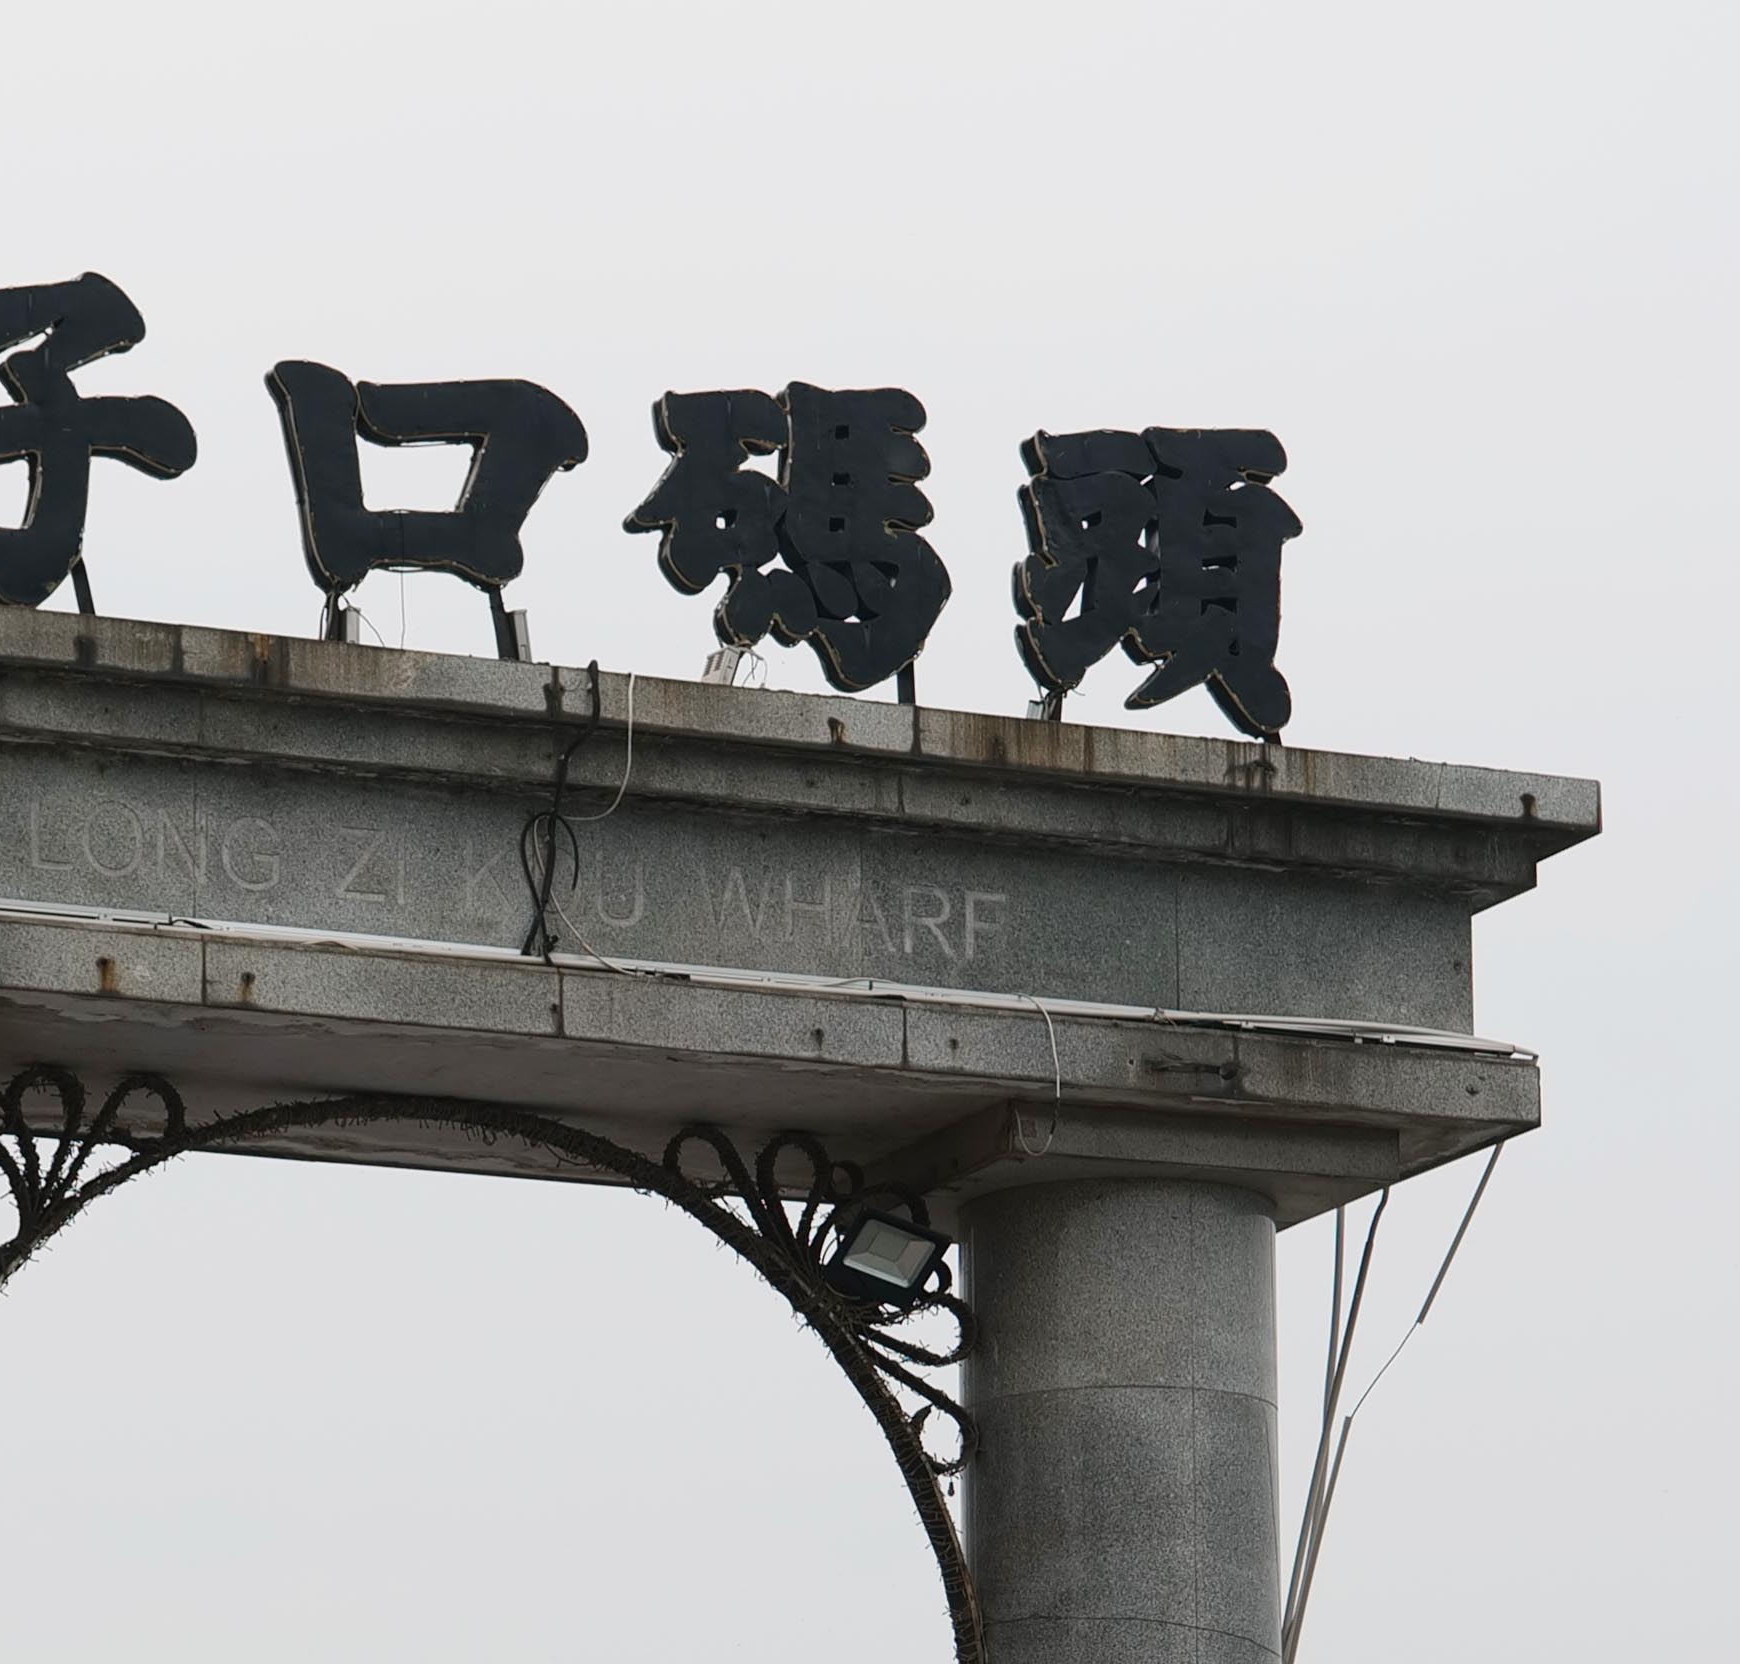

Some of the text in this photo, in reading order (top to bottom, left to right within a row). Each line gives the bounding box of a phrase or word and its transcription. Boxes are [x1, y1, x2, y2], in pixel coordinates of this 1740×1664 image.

[27, 810, 282, 892] LONG
[332, 824, 410, 906] ZI
[696, 862, 1010, 962] WHARF
